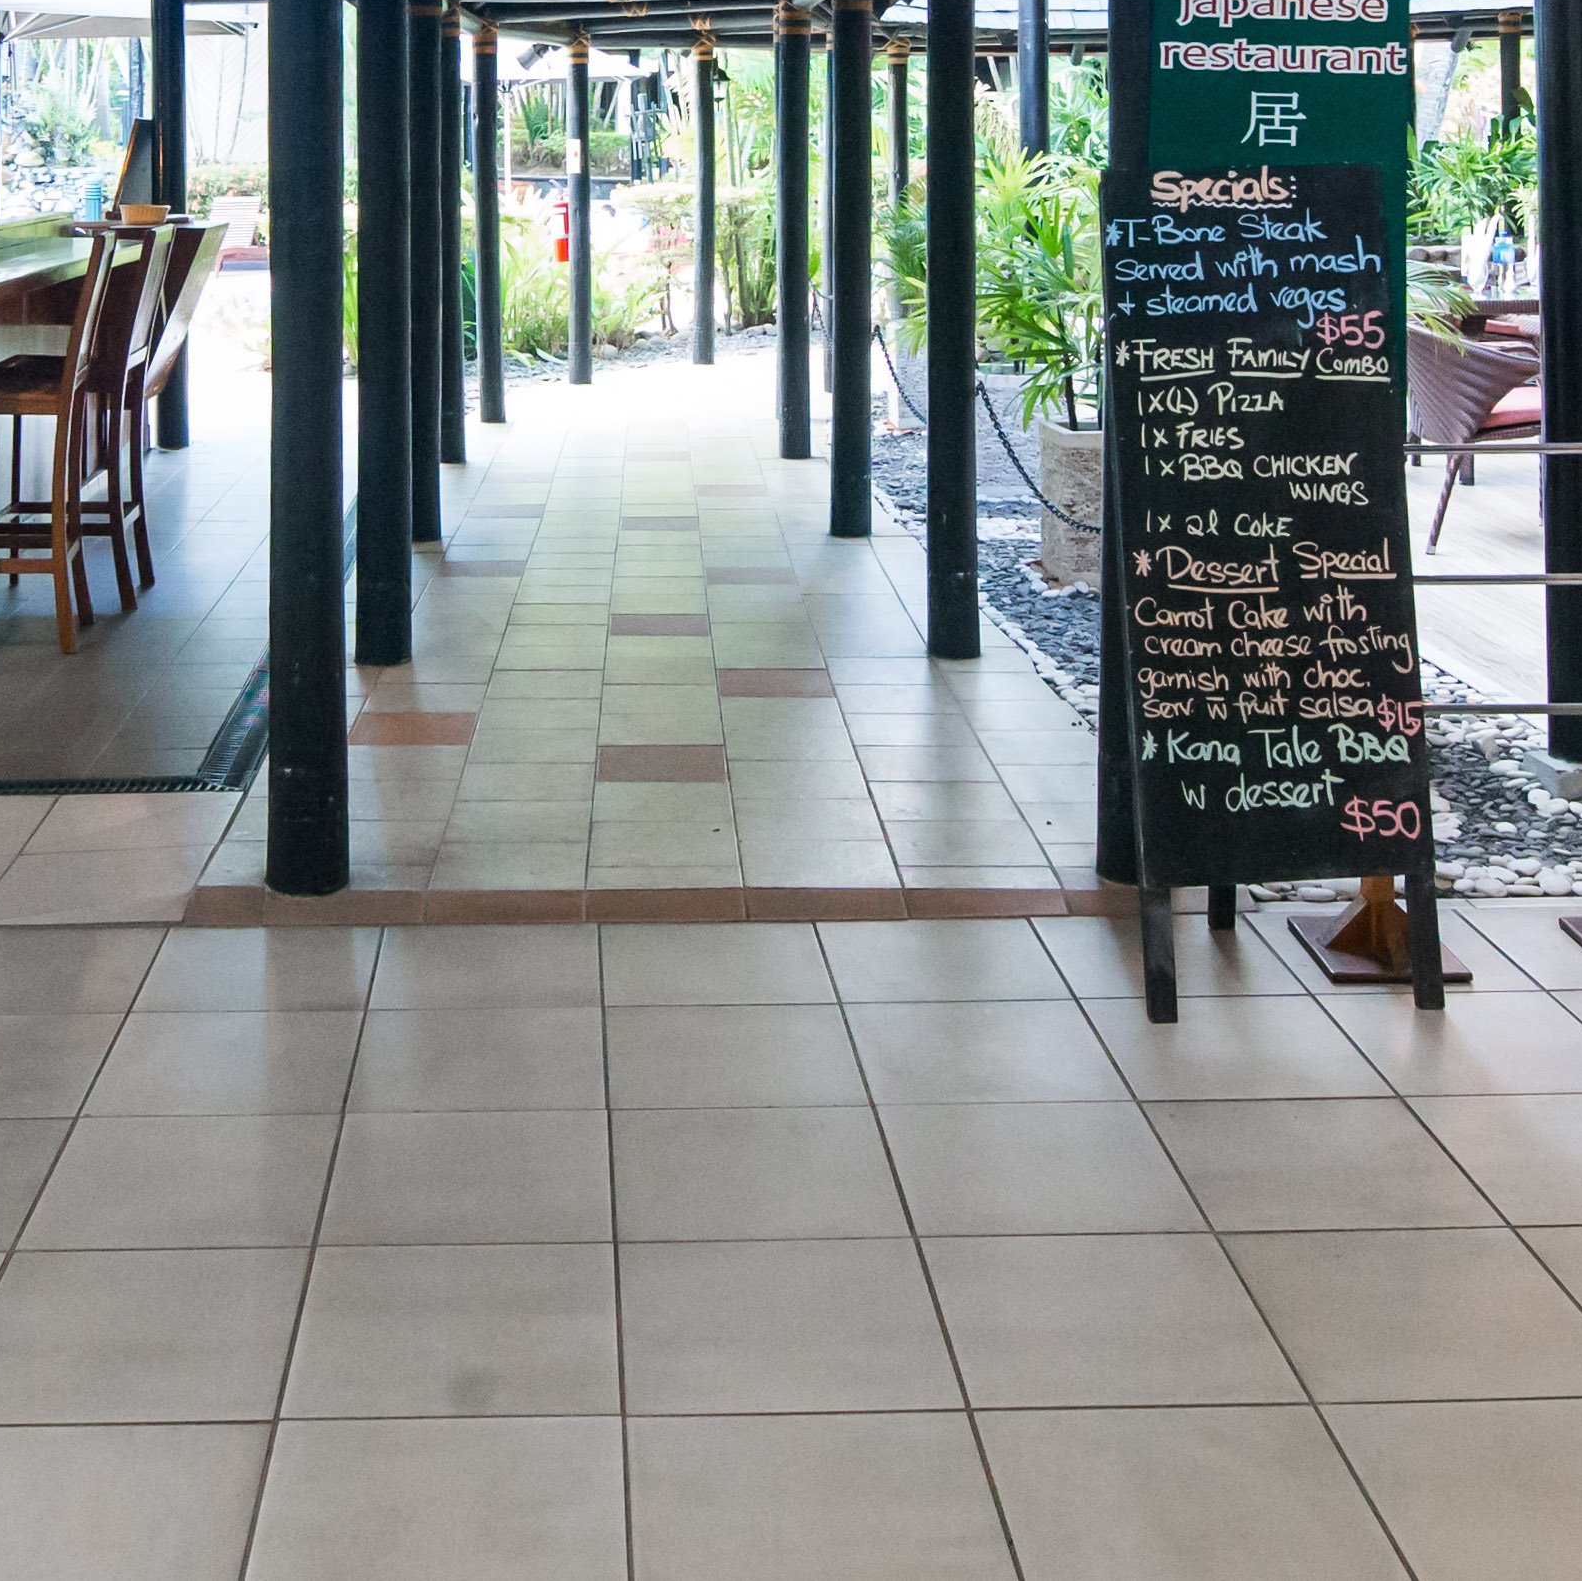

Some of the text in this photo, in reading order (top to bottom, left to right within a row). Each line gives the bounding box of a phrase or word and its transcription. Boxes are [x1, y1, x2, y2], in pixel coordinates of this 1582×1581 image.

[1160, 39, 1407, 75] restaurant
[1241, 91, 1307, 147] 居
[1238, 207, 1328, 243] Steak
[1216, 244, 1278, 278] with
[1290, 234, 1382, 273] mash
[1316, 310, 1385, 349] $55
[1176, 422, 1245, 450] FRIES
[1179, 453, 1243, 482] BBQ
[1253, 452, 1358, 478] CHICKEN
[1289, 481, 1369, 505] WINGS
[1156, 537, 1389, 585] Dessert Special
[1303, 584, 1367, 624] with
[1230, 632, 1312, 657] cheese
[1319, 625, 1414, 674] frosting
[1137, 666, 1230, 699] garnish
[1243, 661, 1291, 689] with
[1233, 689, 1289, 723] fruit
[1299, 692, 1375, 719] salsa
[1377, 693, 1423, 736] $15
[1327, 723, 1412, 764] BBQ
[1225, 768, 1346, 812] dessert
[1340, 795, 1421, 842] $50
